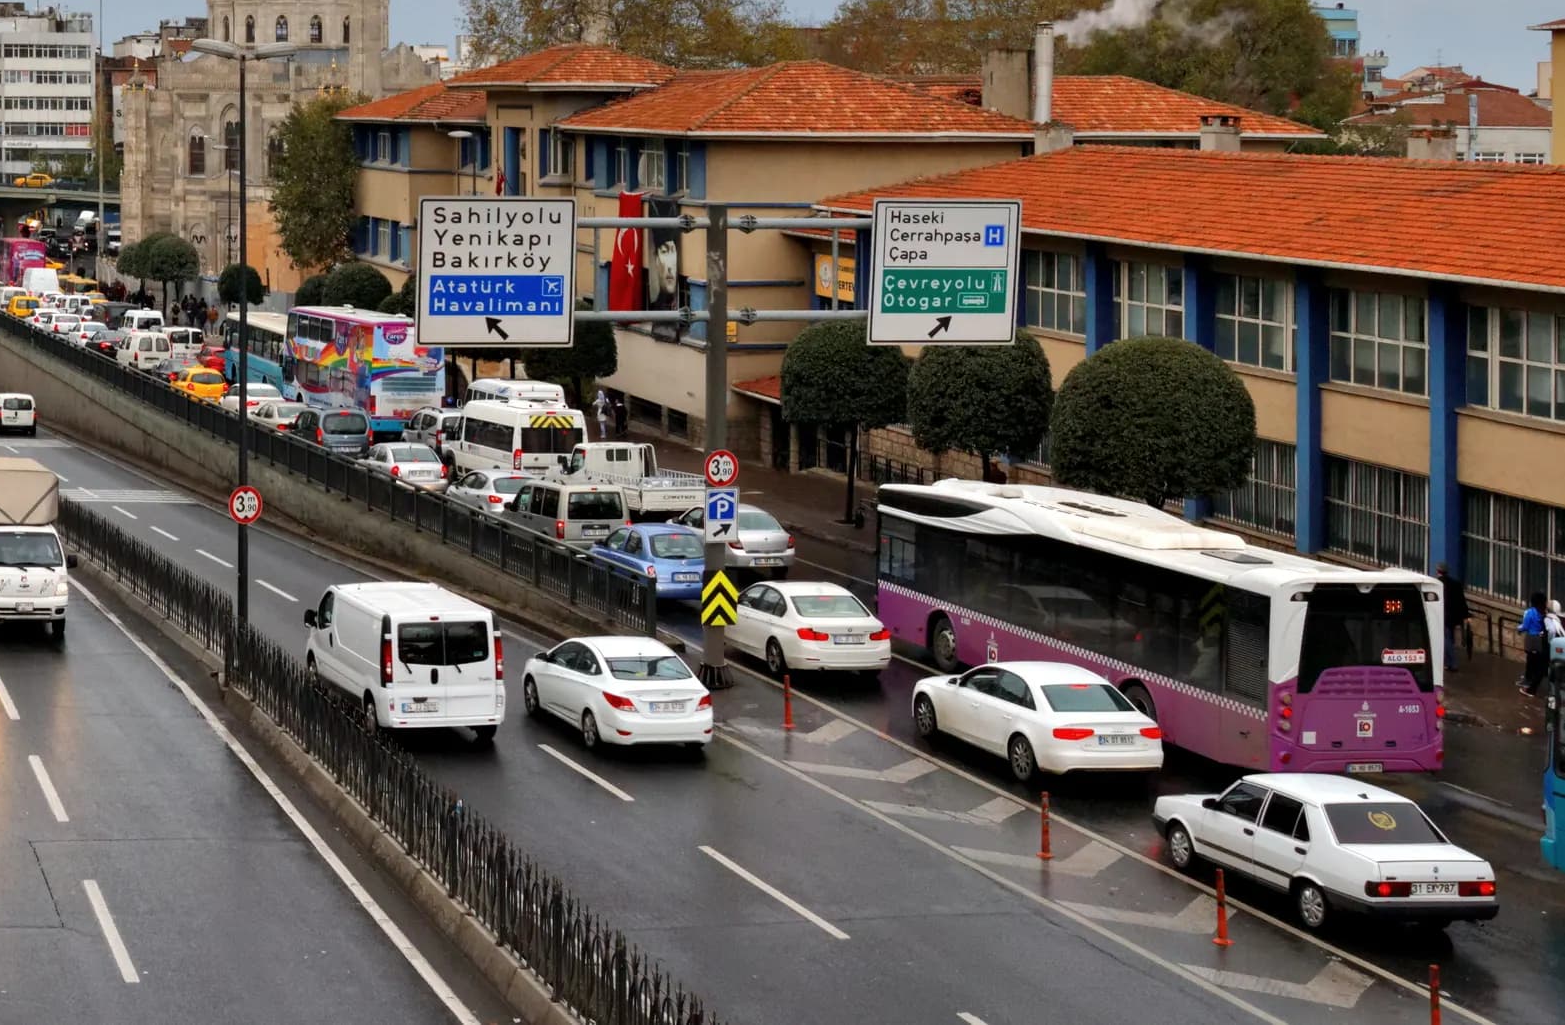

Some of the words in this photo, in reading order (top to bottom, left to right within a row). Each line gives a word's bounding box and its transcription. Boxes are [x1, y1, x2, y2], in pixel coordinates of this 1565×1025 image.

[433, 207, 561, 228] Sahilyolu
[890, 210, 945, 224] Haseki
[434, 229, 551, 250] Yenikapı
[890, 228, 981, 245] Cerrahpaşa
[432, 251, 551, 272] Bakırköy
[889, 247, 928, 263] Çapa
[432, 279, 515, 293] Atatürk
[884, 275, 985, 293] Çevreyolu
[433, 298, 559, 311] Havalimanı
[883, 293, 952, 310] Otogar
[711, 459, 721, 476] 3
[236, 495, 245, 513] 3
[1412, 883, 1422, 894] 31
